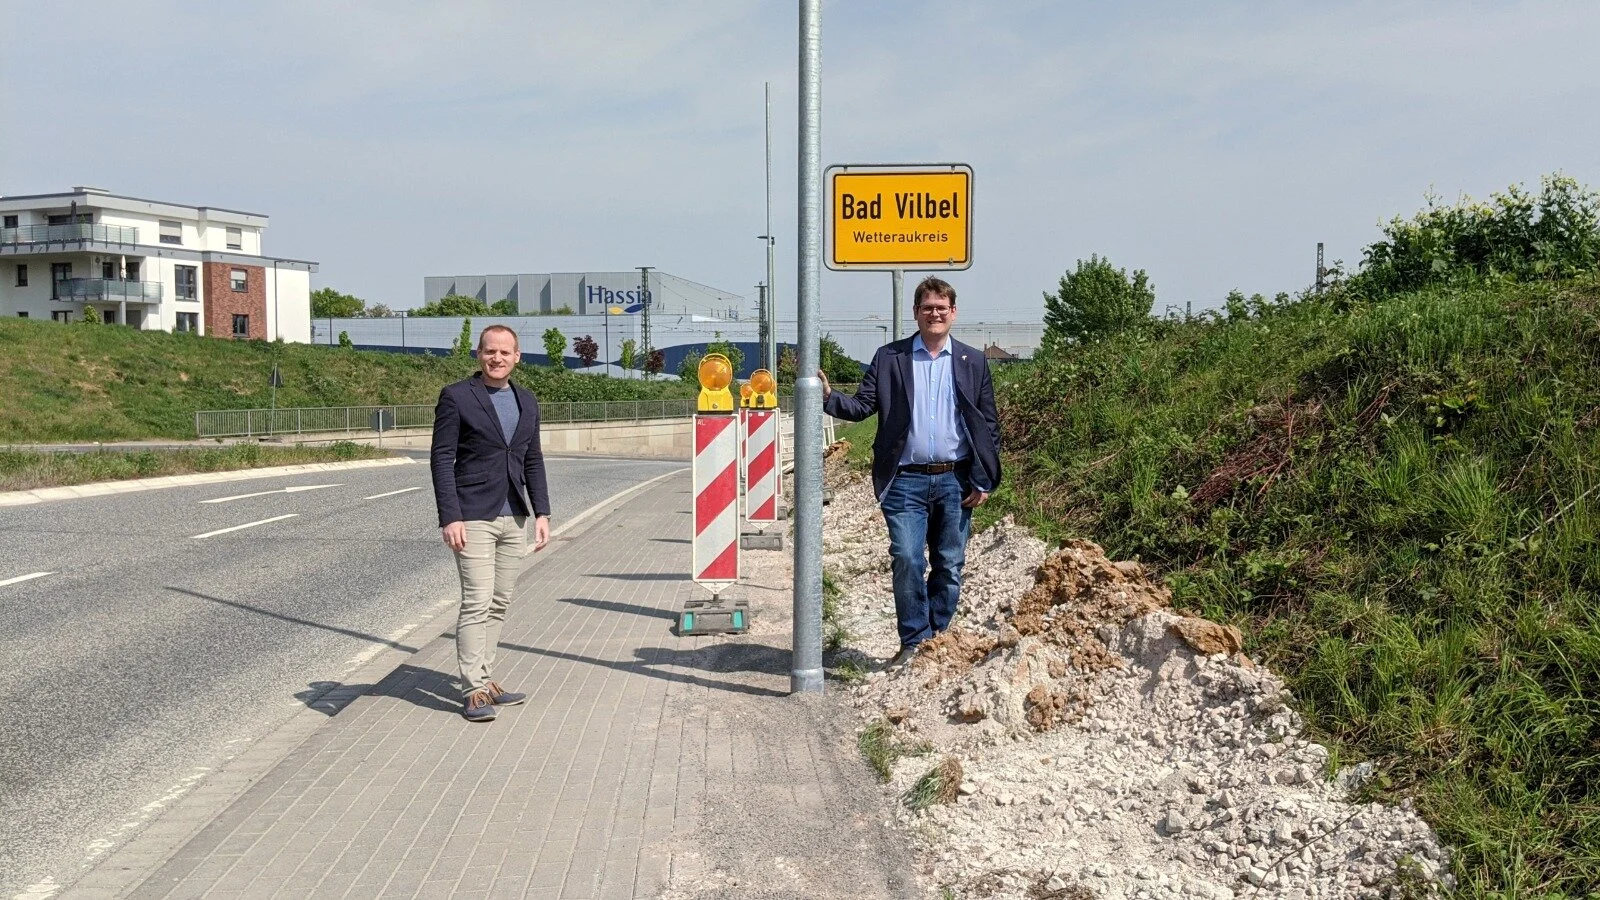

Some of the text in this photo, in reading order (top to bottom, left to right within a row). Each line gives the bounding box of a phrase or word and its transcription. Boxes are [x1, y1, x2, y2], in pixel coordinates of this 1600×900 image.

[842, 192, 959, 220] Bad Vilbel
[853, 231, 948, 243] Wetteraukreis
[587, 285, 652, 304] Hassia
